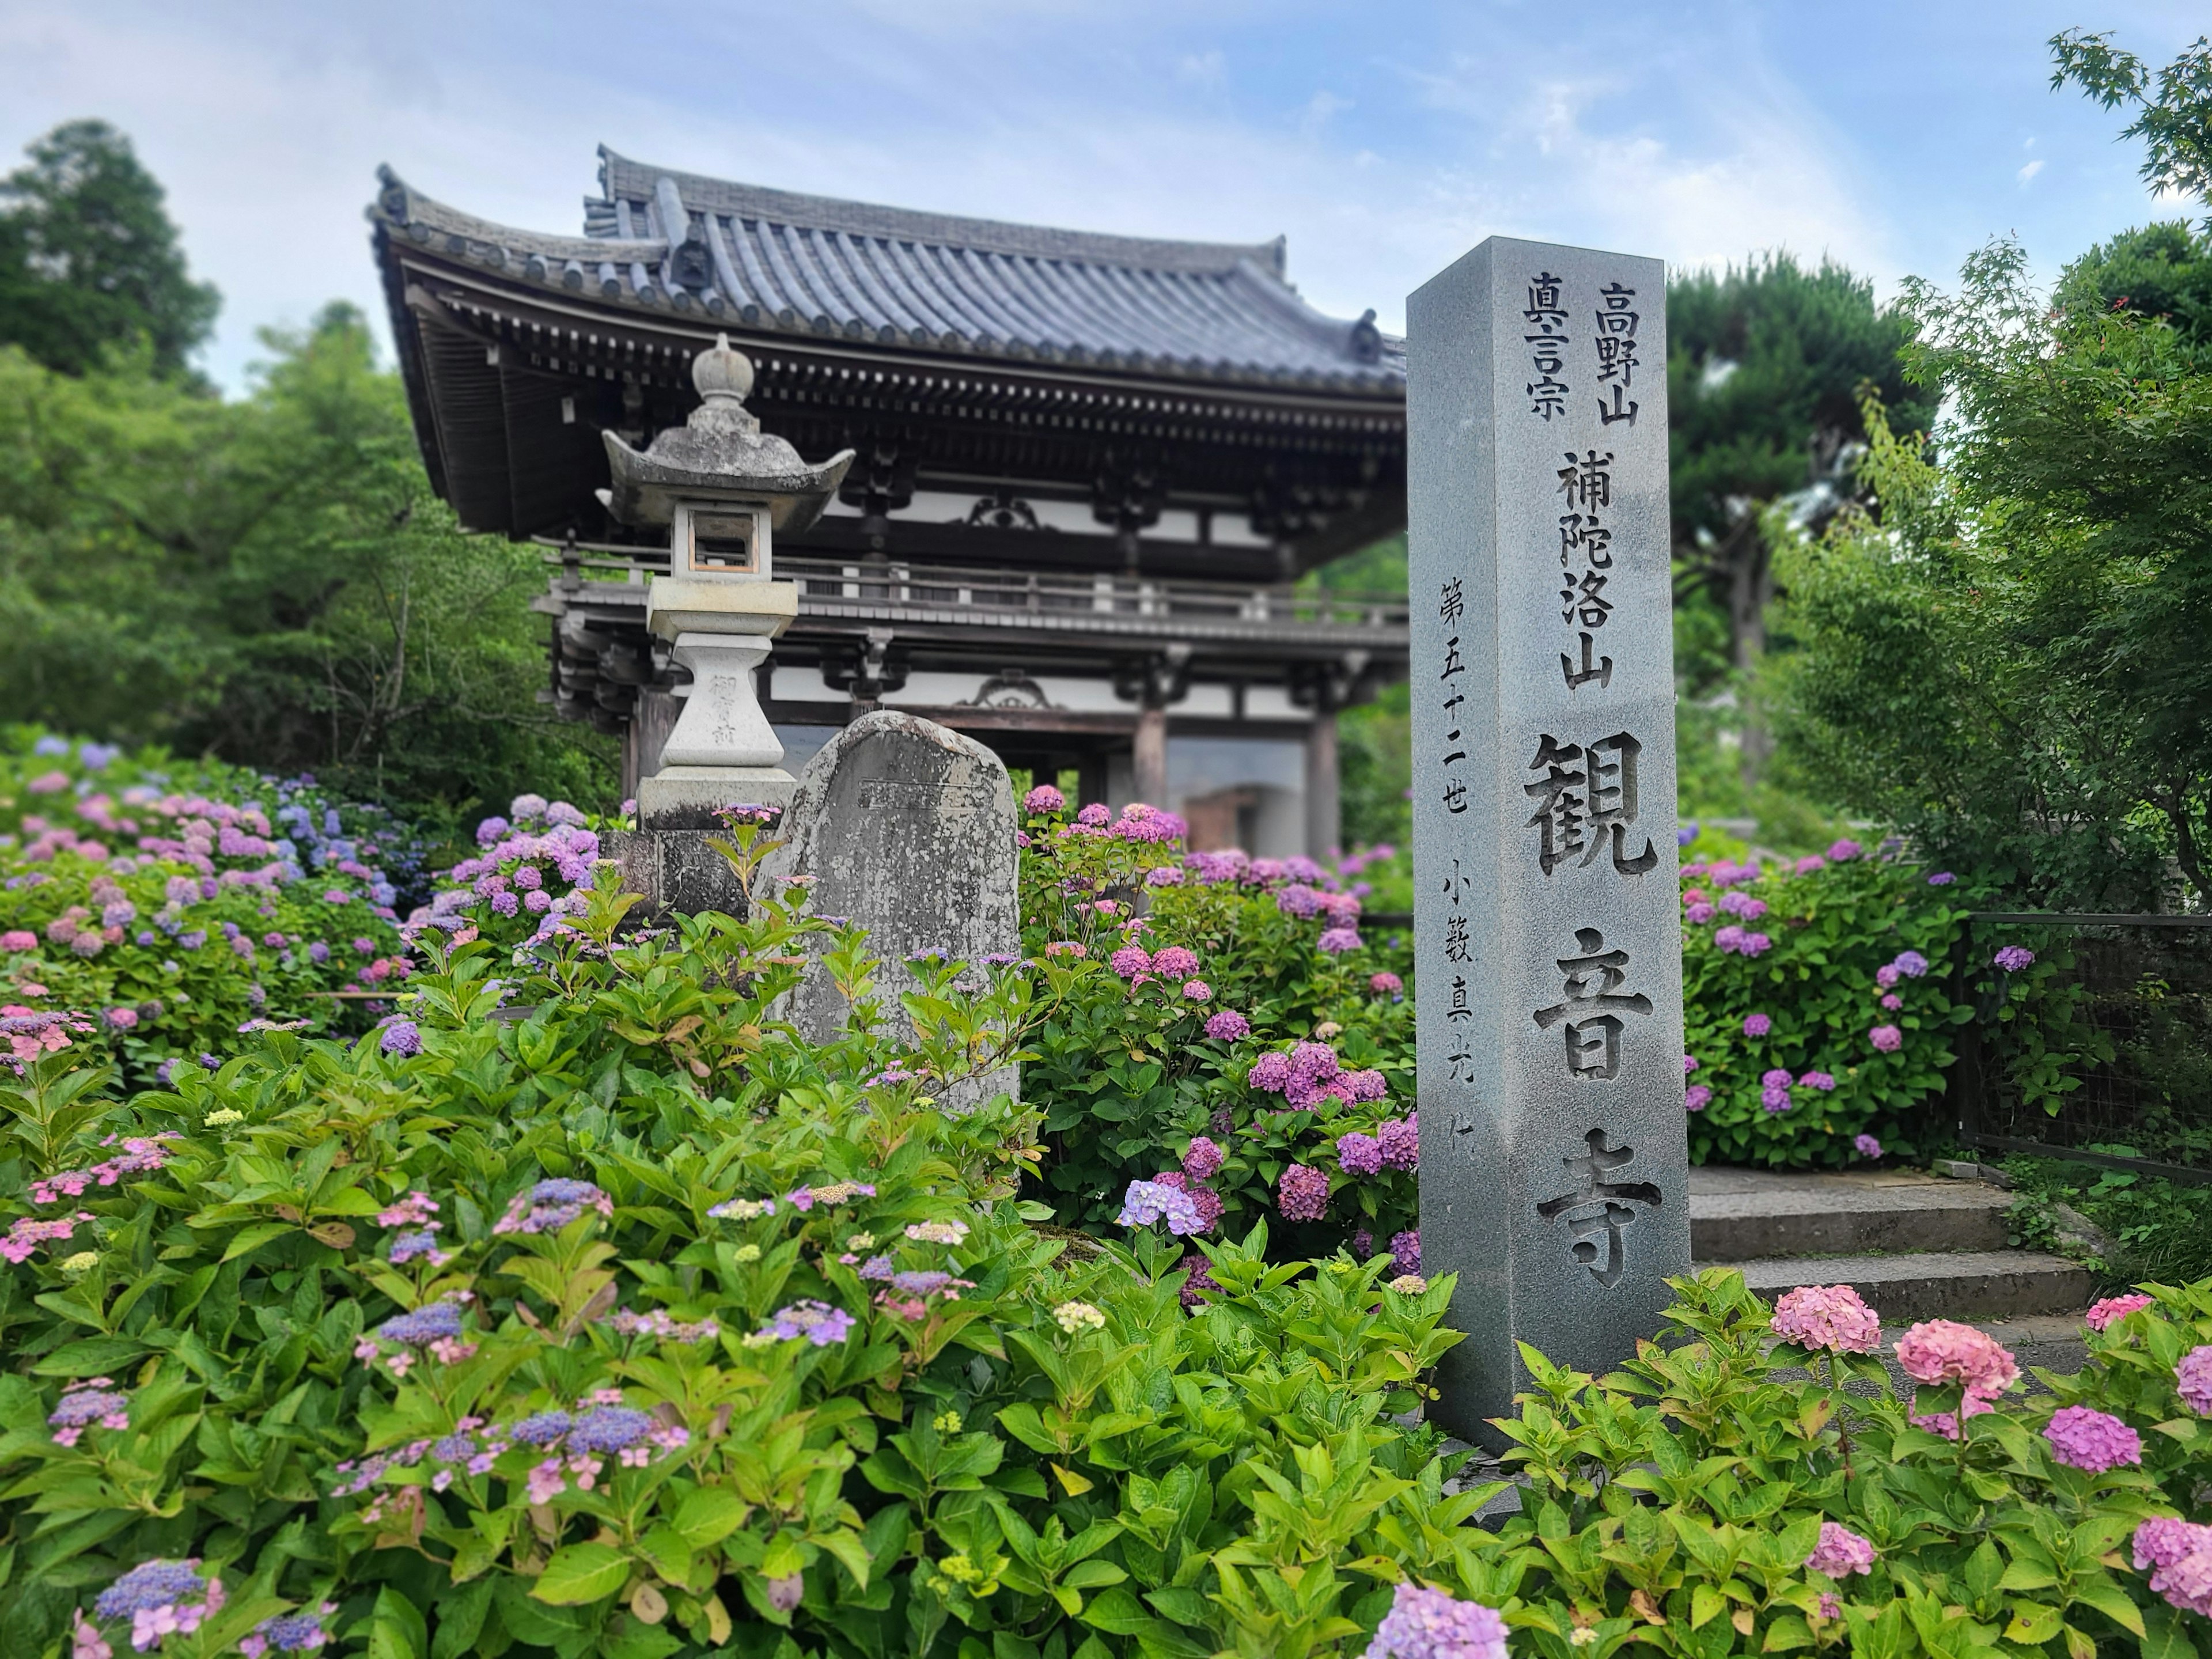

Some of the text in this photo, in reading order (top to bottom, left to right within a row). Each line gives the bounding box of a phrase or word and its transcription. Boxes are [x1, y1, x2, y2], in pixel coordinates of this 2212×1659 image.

[1524, 271, 1570, 422] 真言宗
[1596, 282, 1641, 427] 高野山
[1440, 577, 1468, 815] 第五十二世
[1523, 449, 1663, 1289] 補陀洛山 観音寺
